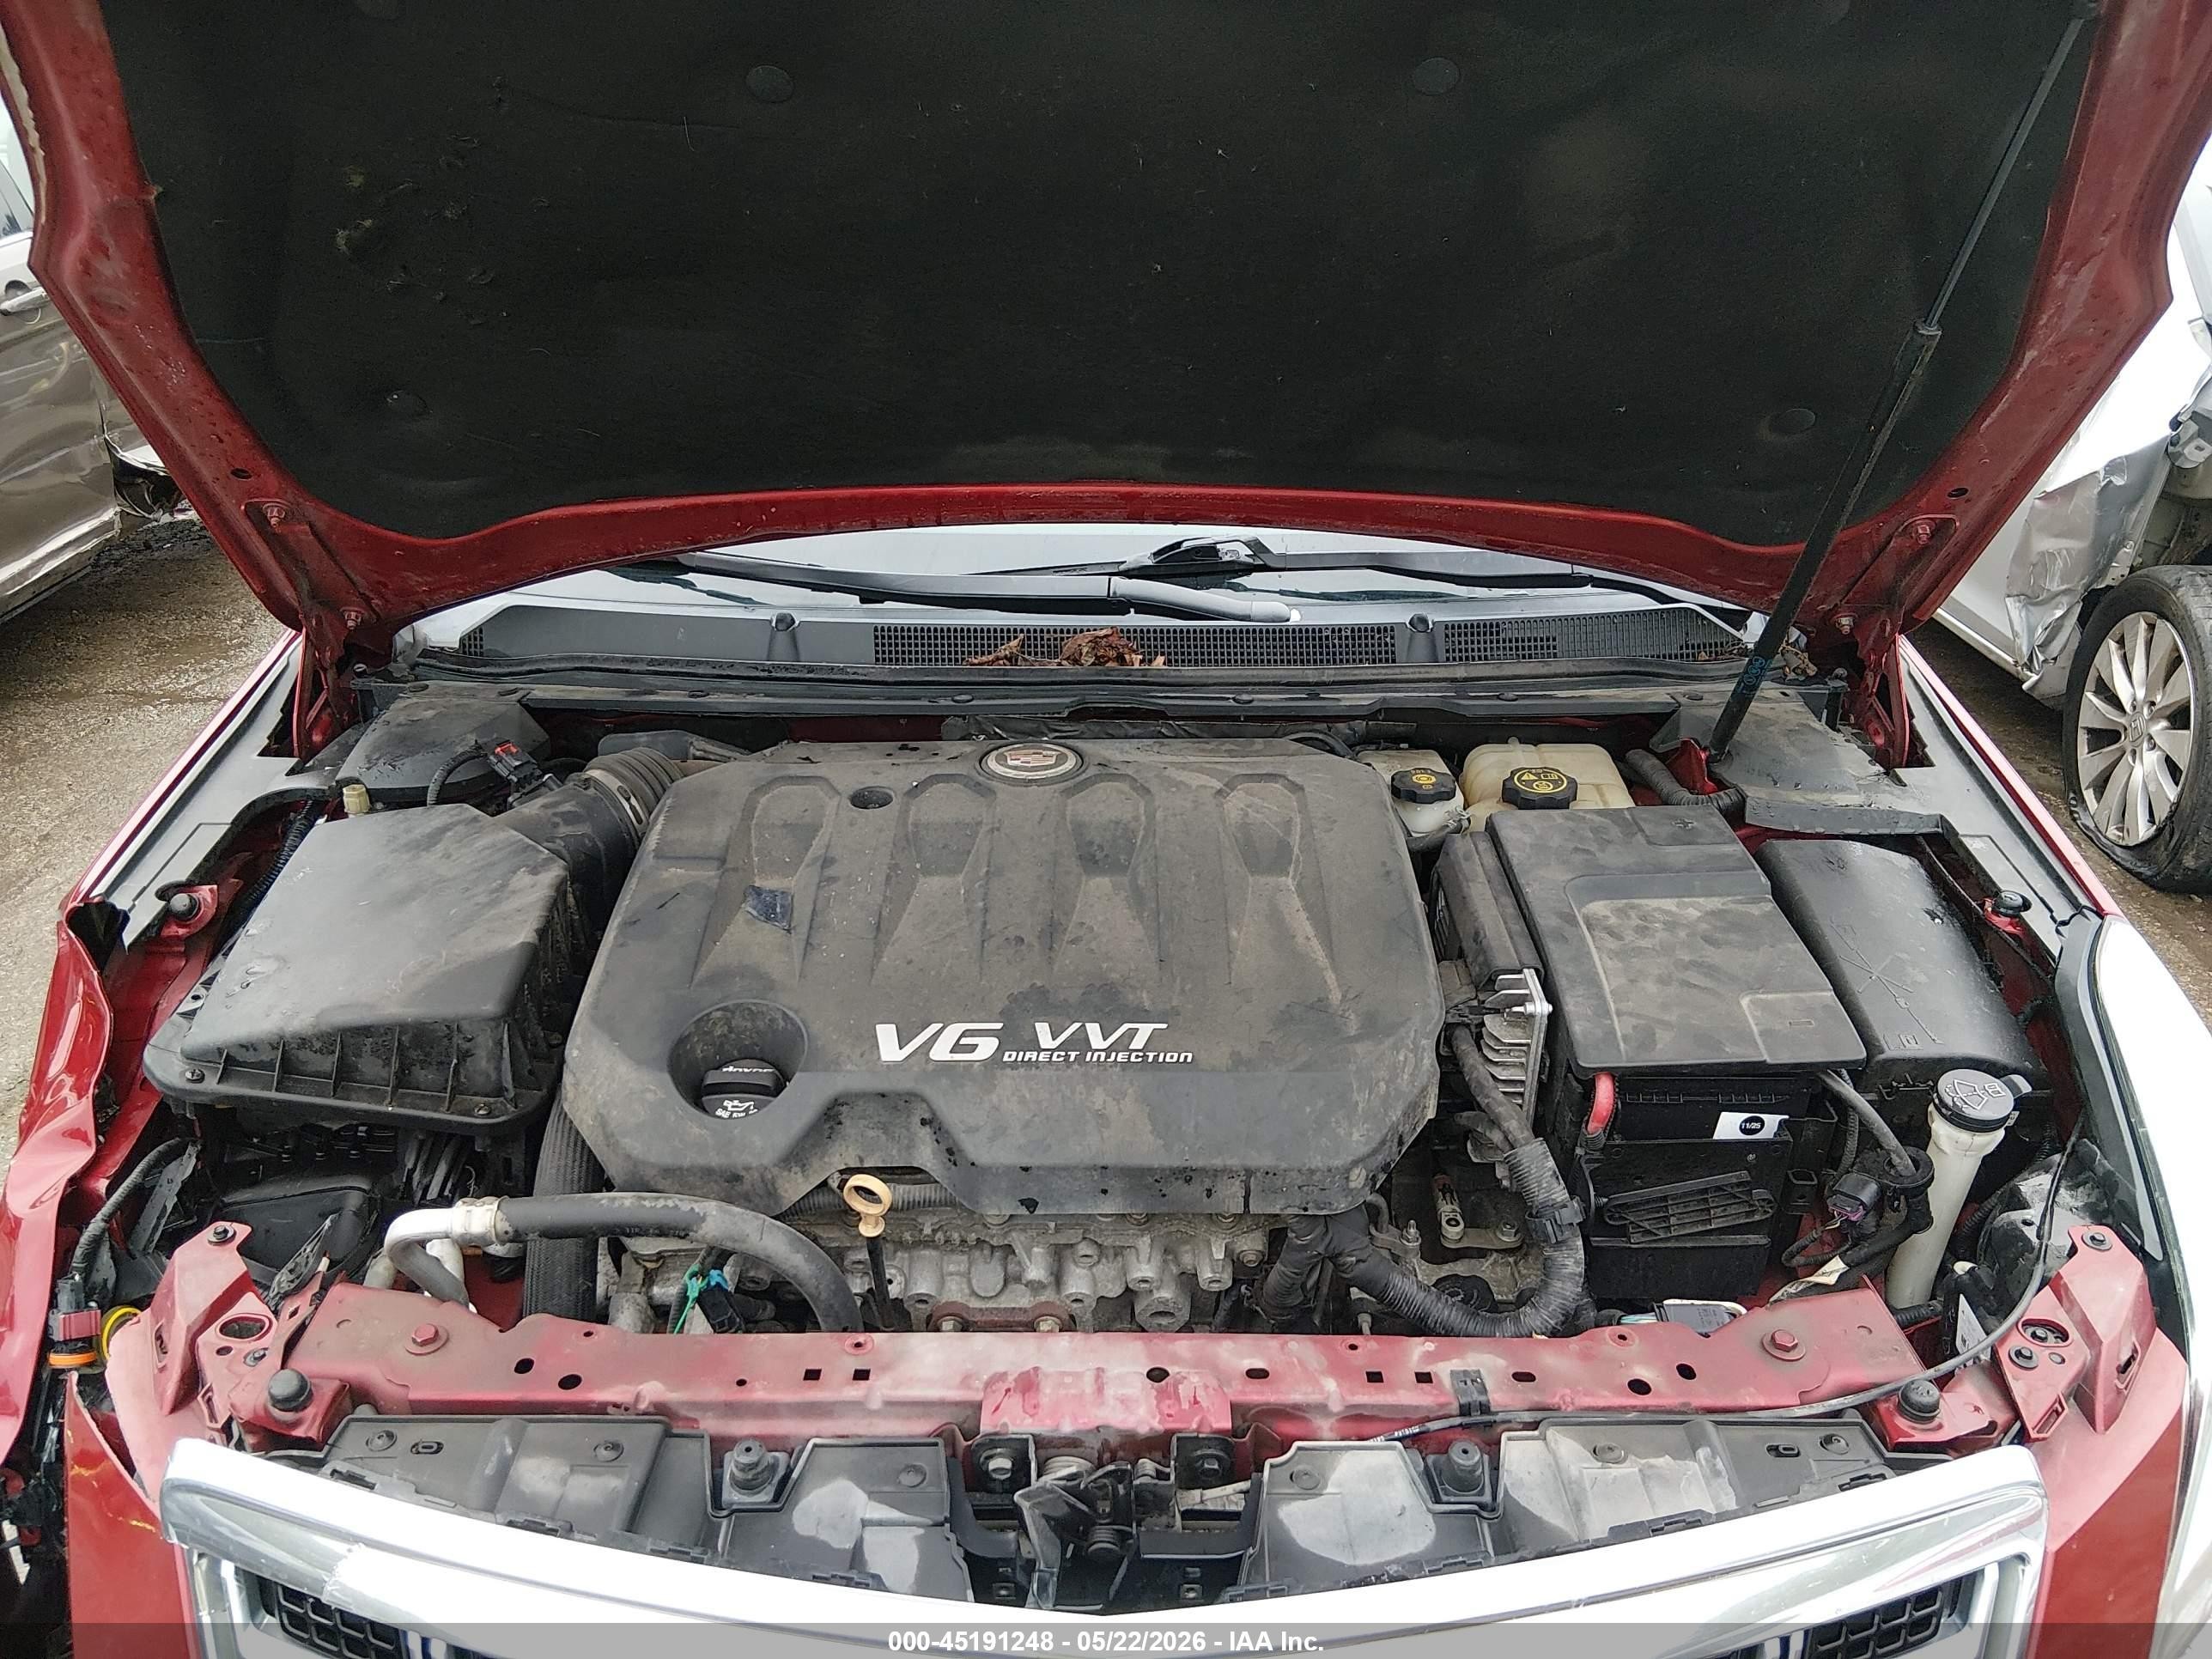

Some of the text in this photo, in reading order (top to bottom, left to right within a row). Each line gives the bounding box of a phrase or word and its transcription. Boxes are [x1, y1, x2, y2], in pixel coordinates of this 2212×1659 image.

[876, 1023, 1004, 1061] V6
[1035, 1023, 1168, 1049] VVT
[1003, 1051, 1192, 1063] DIRECT INJECTION
